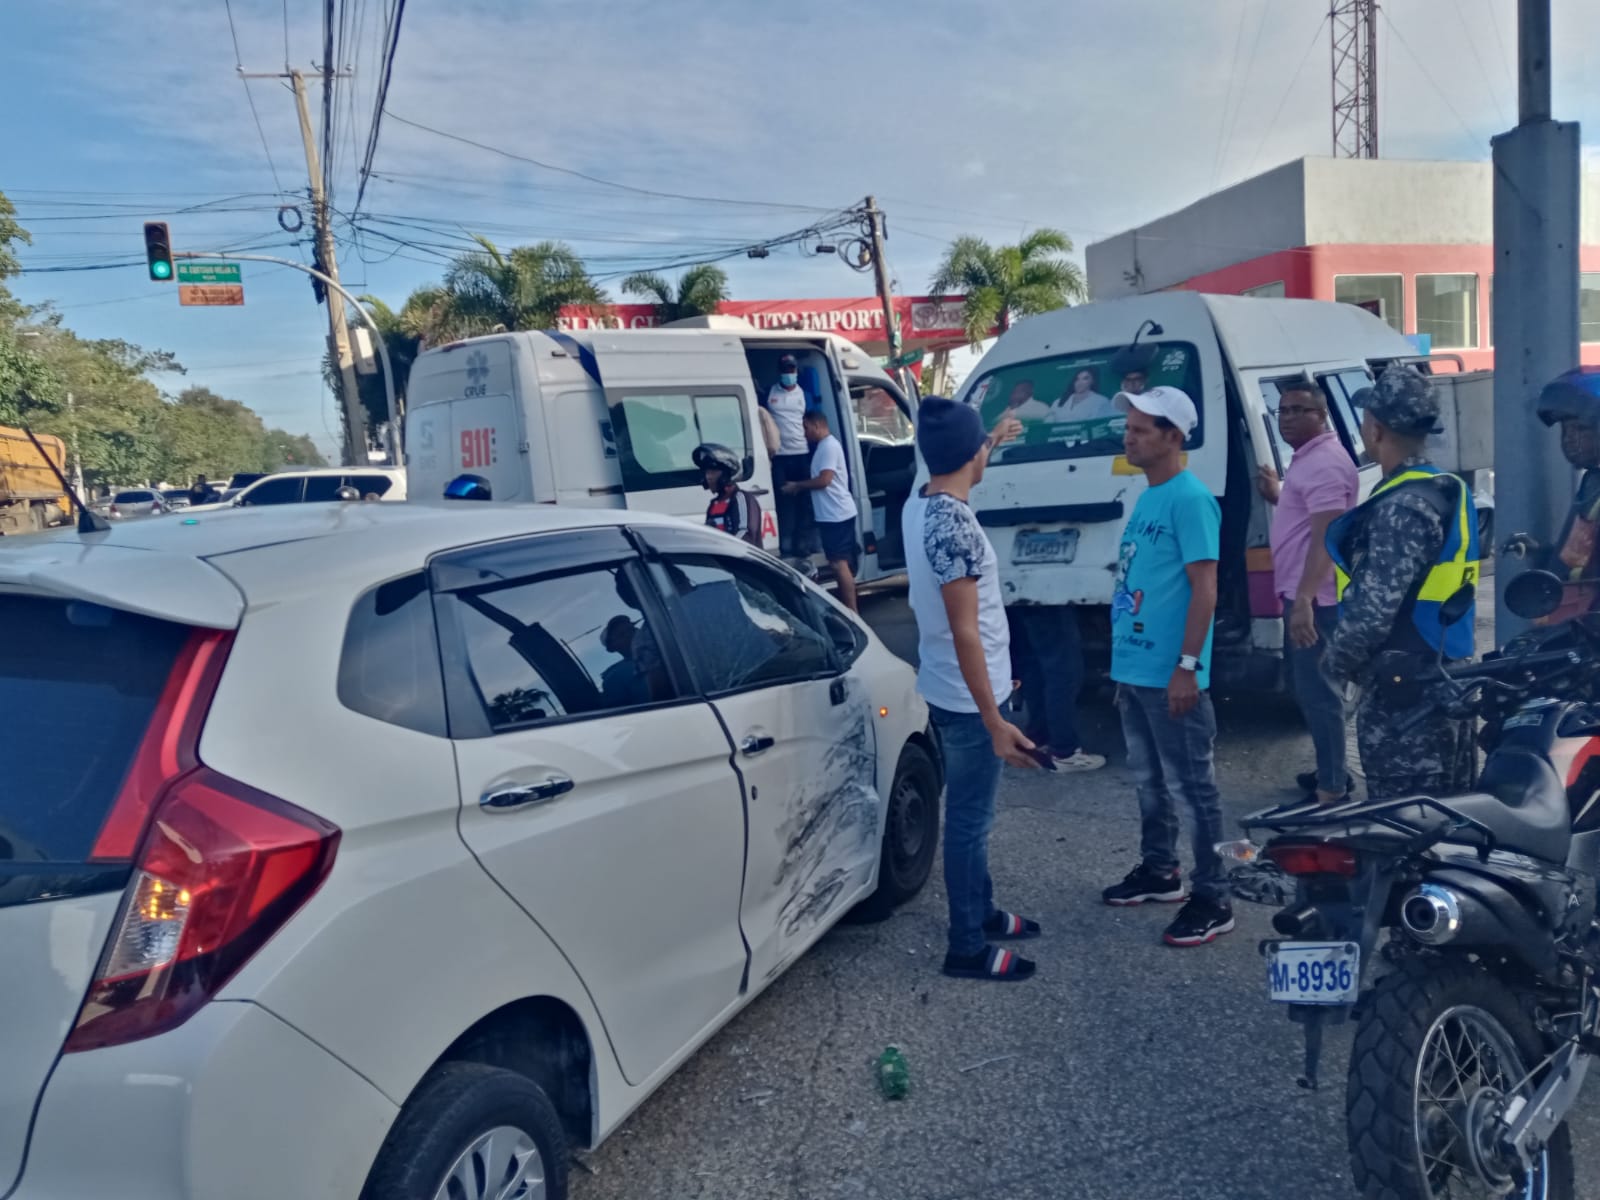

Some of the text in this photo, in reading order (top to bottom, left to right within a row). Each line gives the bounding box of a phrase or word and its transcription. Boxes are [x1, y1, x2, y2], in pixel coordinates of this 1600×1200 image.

[800, 308, 885, 331] IMPORT
[460, 428, 491, 469] 911
[1271, 960, 1351, 992] M-8936
